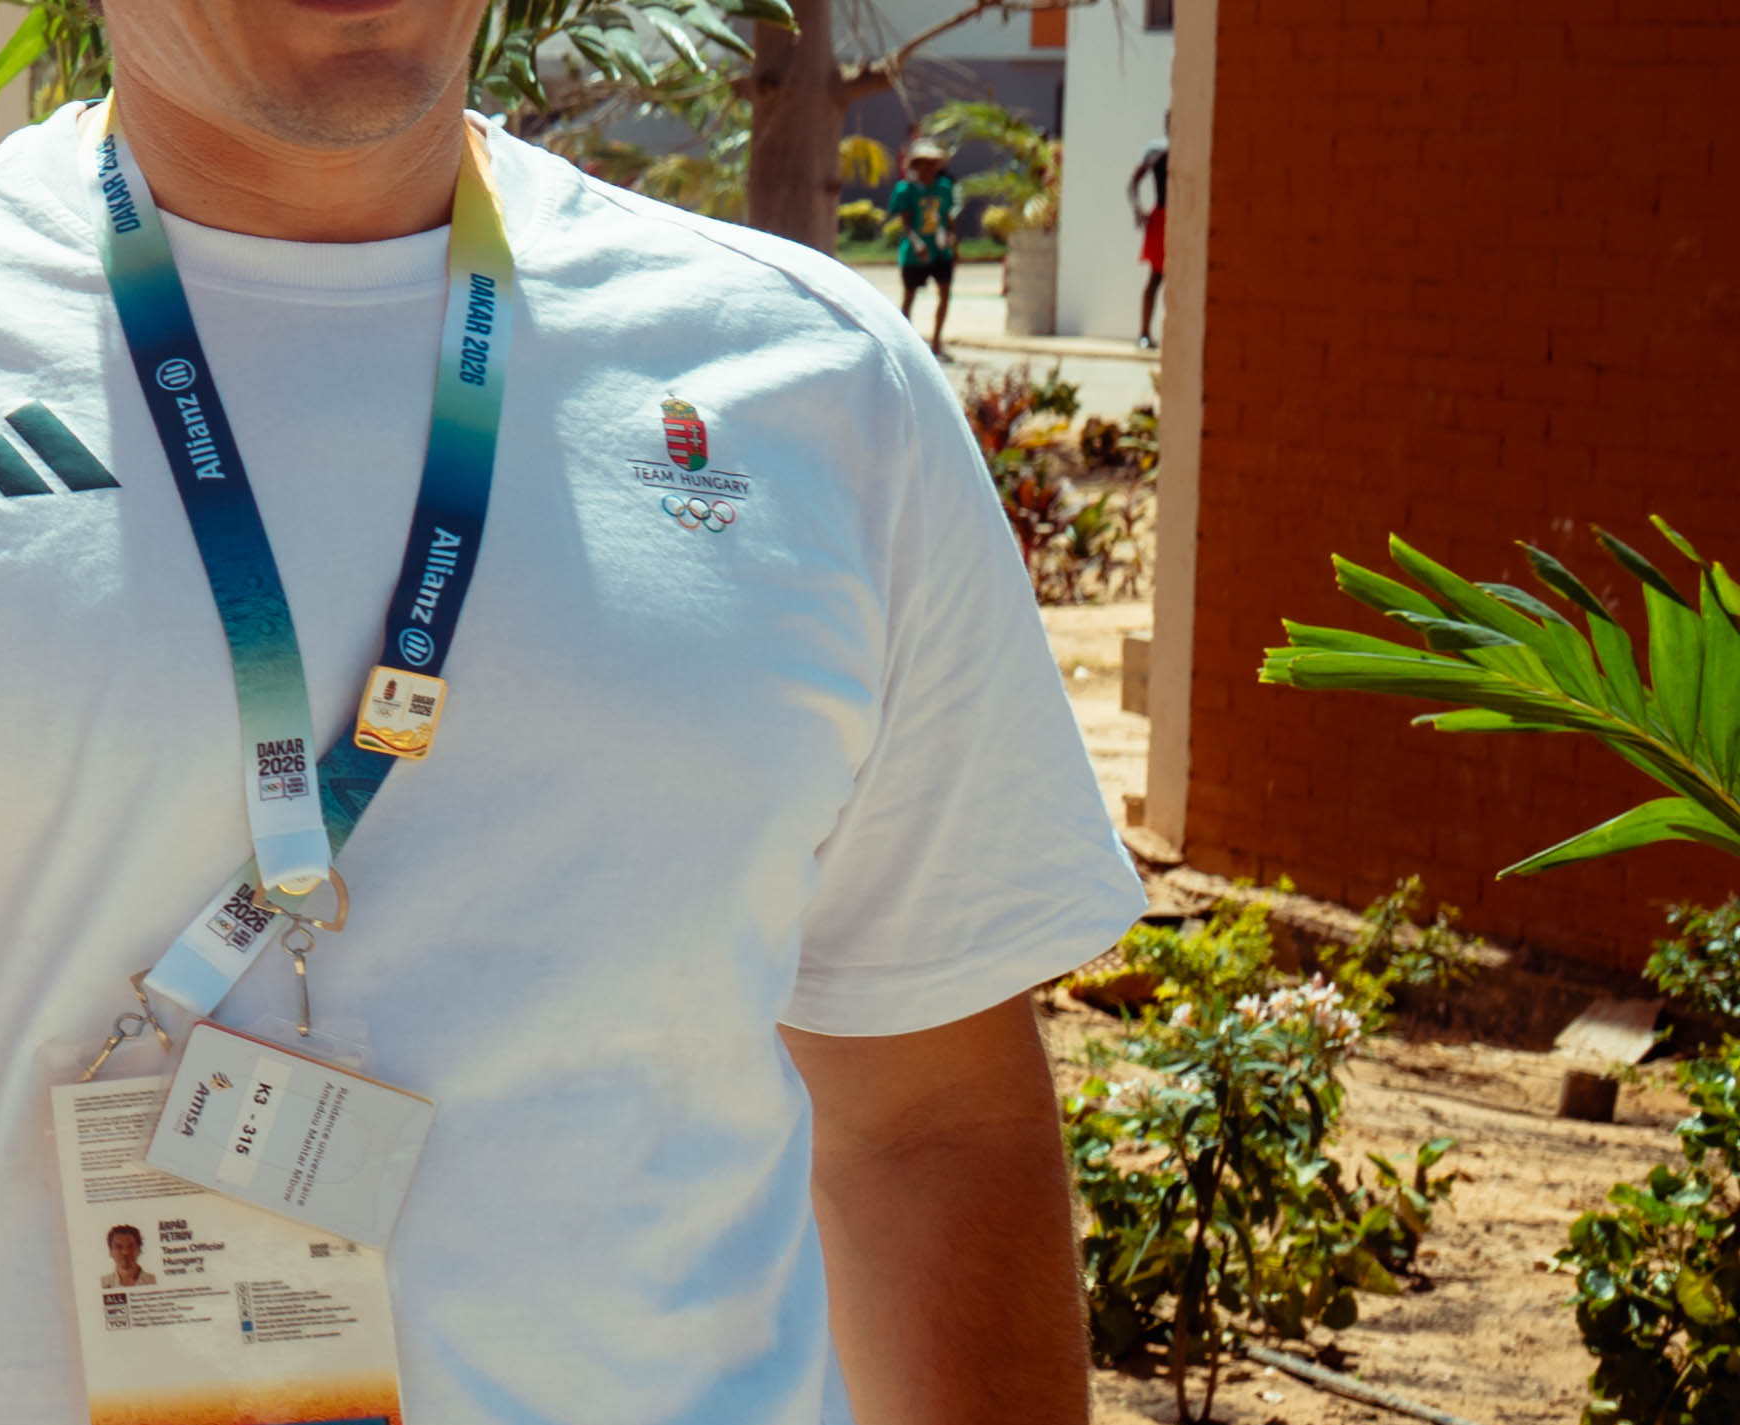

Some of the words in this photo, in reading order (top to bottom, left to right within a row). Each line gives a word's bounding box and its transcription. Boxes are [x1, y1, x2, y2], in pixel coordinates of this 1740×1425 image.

[102, 173, 142, 234] DAKAR
[465, 272, 496, 337] DAKAR
[459, 336, 489, 387] 2026
[175, 392, 227, 481] Allianz
[633, 466, 674, 483] TEAM
[681, 474, 749, 495] HUNGARY
[410, 526, 462, 625] Allianz
[257, 738, 305, 758] DAKAR
[259, 754, 306, 776] 2026
[223, 896, 268, 933] 2026
[253, 1082, 273, 1105] K3
[311, 1081, 335, 1126] Amadou
[235, 1124, 257, 1156] 315
